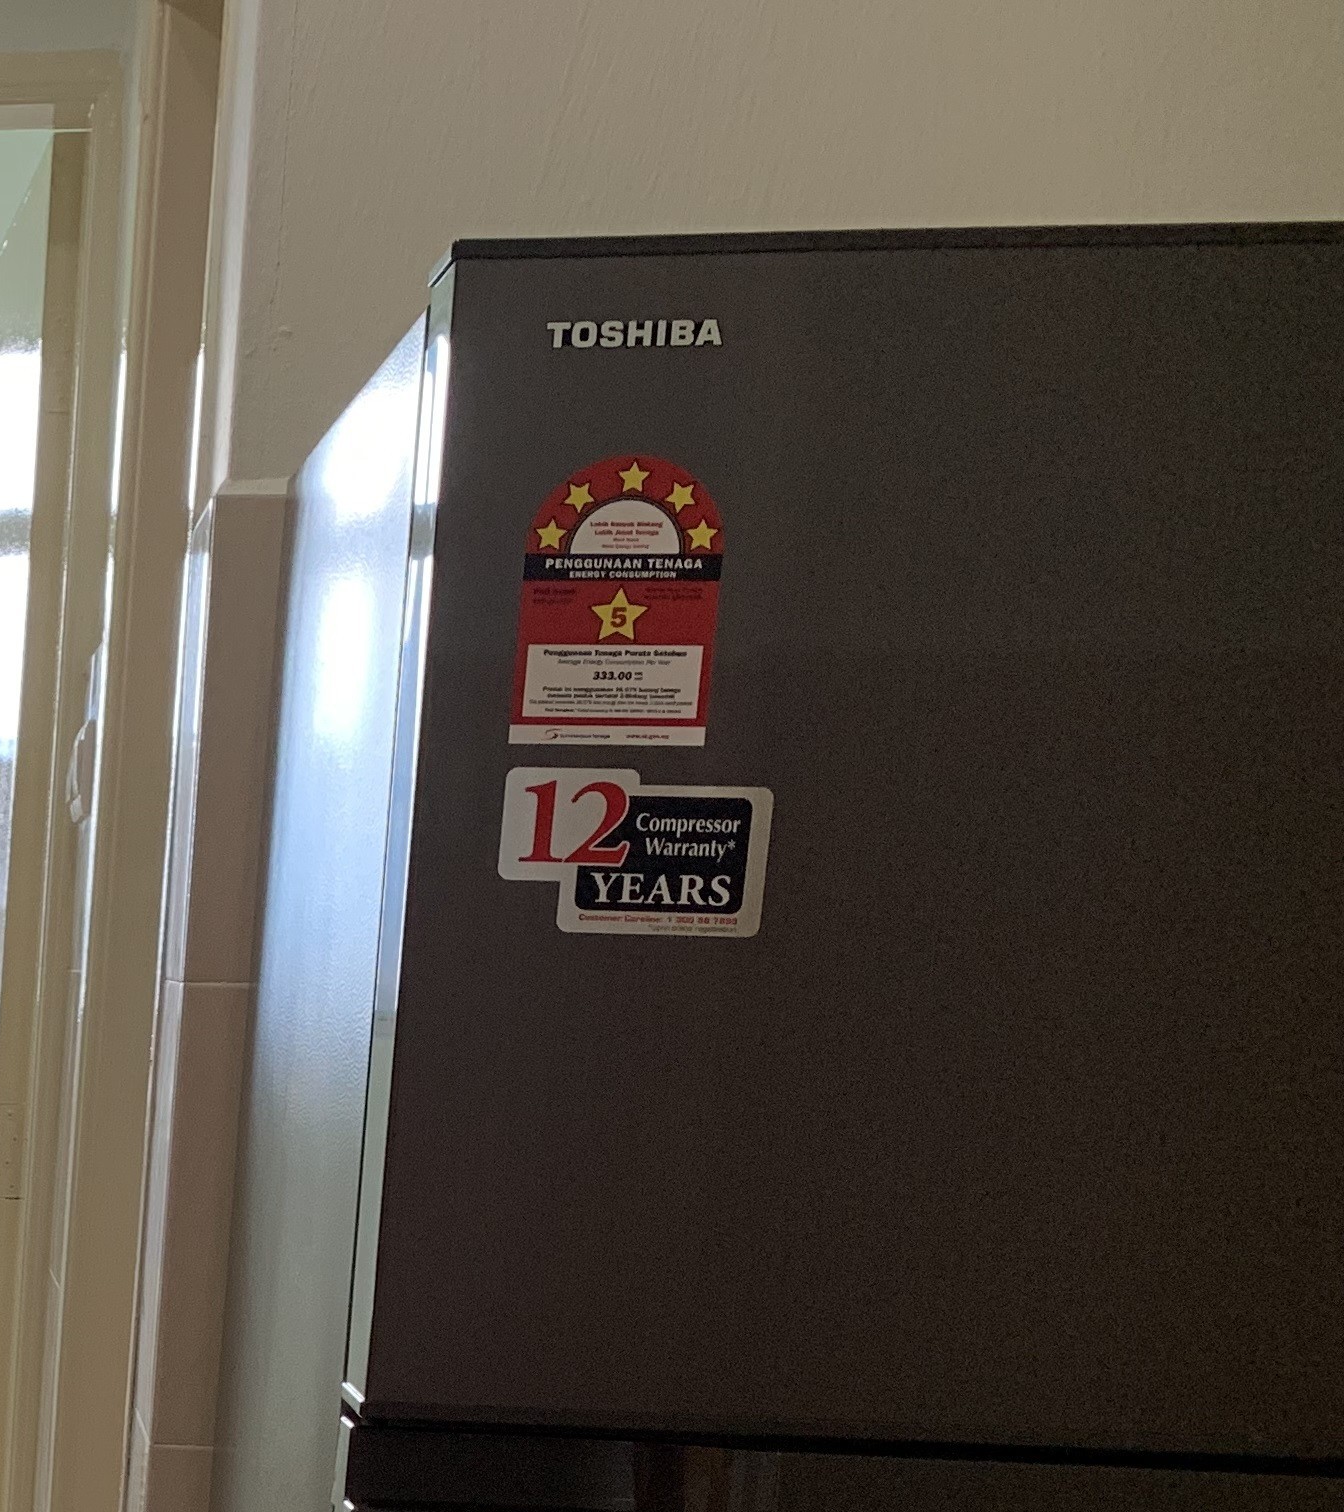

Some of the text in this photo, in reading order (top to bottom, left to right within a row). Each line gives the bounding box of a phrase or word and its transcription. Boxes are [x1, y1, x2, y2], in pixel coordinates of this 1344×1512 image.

[546, 318, 723, 349] TOSHIBA
[545, 557, 703, 570] PENGGUNAAN TENAGA
[568, 570, 677, 579] ENERGY CONSUMPTION
[610, 606, 627, 629] 5
[592, 670, 633, 681] 333.00
[518, 779, 631, 868] 12
[635, 812, 742, 838] Compressor
[589, 871, 732, 907] YEARS
